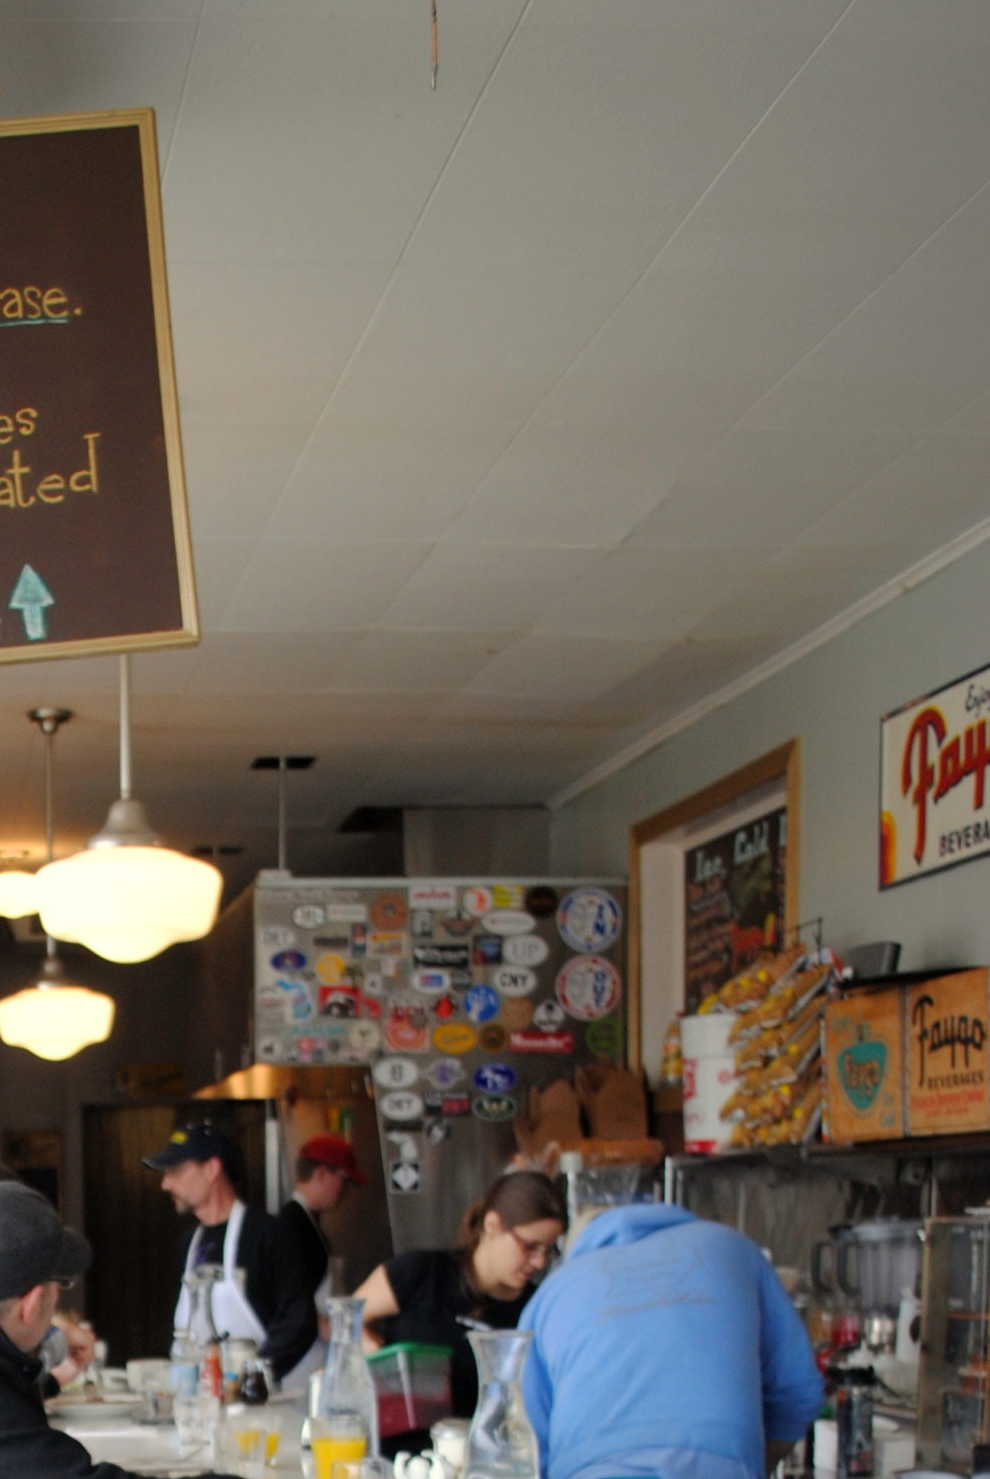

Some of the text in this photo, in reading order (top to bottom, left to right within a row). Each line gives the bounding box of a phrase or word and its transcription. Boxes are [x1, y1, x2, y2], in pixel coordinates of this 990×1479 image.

[901, 705, 990, 866] Fay
[499, 972, 528, 988] CNY
[912, 994, 987, 1089] Faygo
[927, 1070, 985, 1090] BEVERAGES
